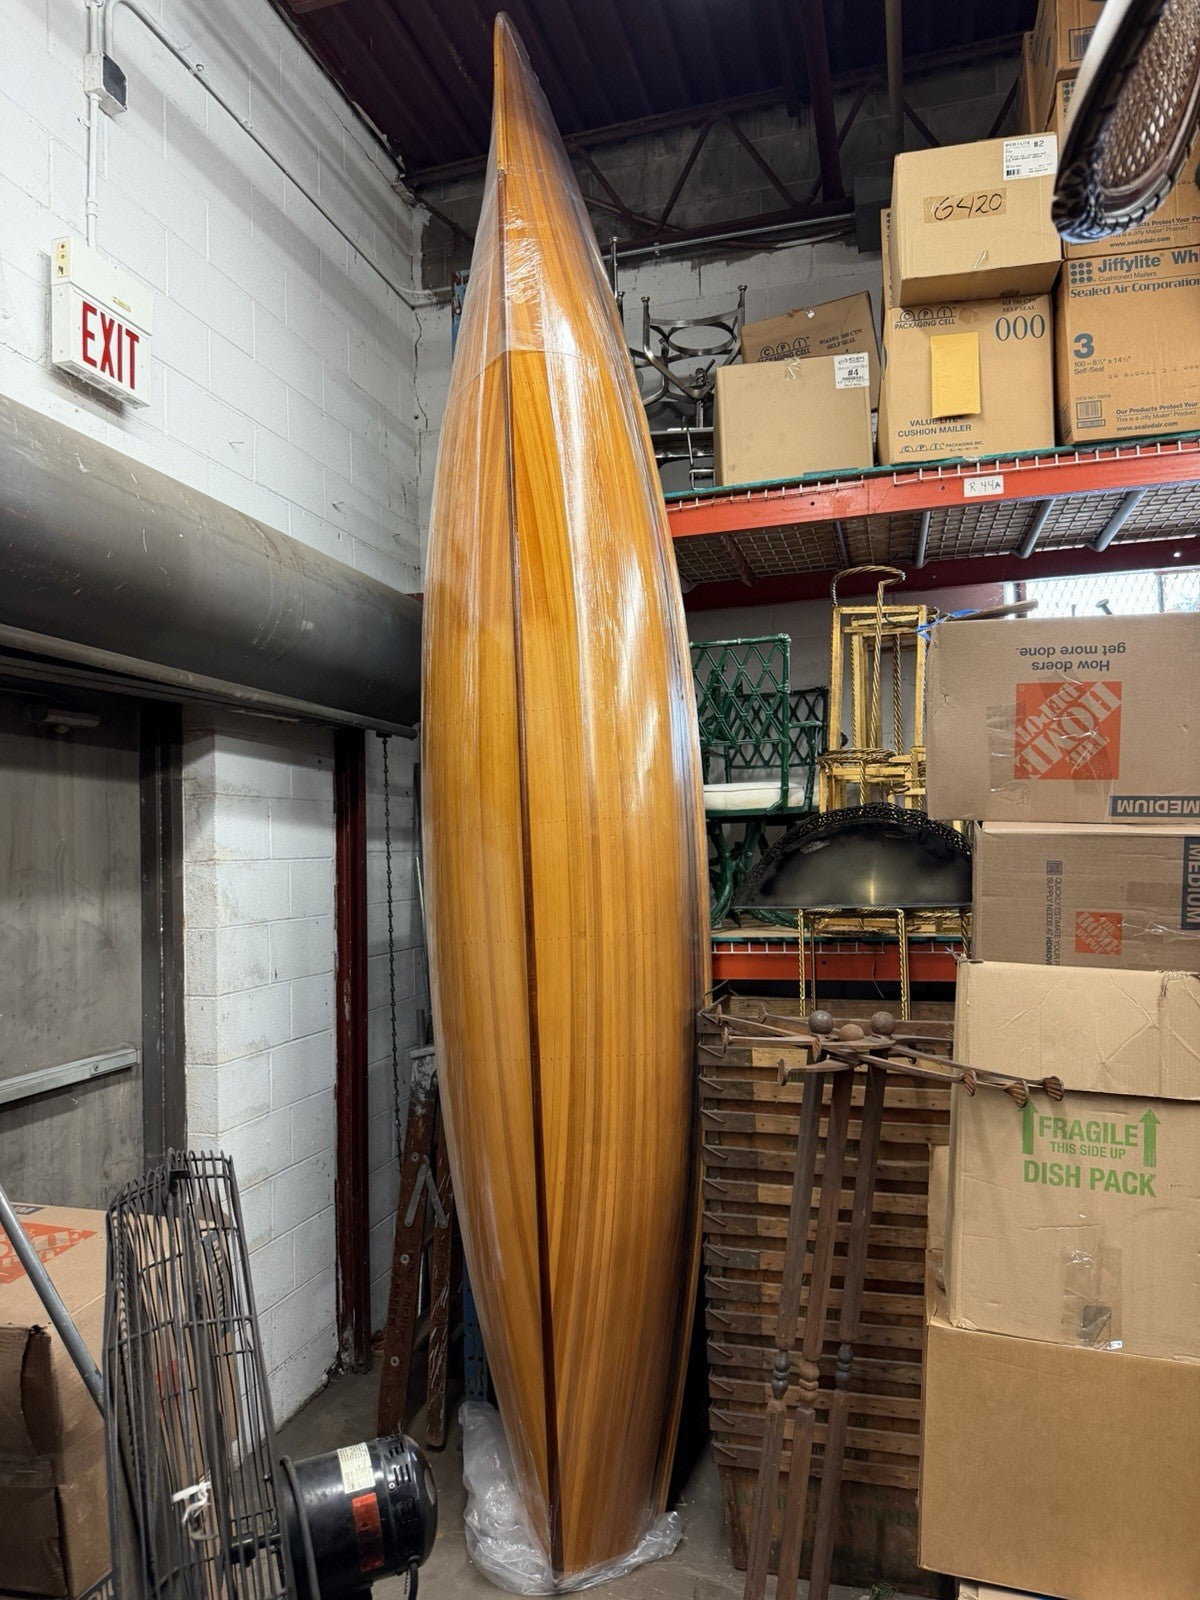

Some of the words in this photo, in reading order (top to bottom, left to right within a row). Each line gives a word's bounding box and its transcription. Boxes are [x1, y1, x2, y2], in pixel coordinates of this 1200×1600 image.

[1109, 236, 1170, 248] www.sealedair.com
[1098, 254, 1161, 273] Jiffylite
[1171, 249, 1200, 265] Wh
[1098, 273, 1132, 282] Cushioned
[1070, 285, 1111, 299] Sealed
[1112, 284, 1130, 294] Air
[895, 320, 937, 330] PACKAGING
[938, 318, 956, 326] CELL
[995, 314, 1045, 342] 000
[82, 300, 139, 390] EXIT
[795, 347, 811, 356] CELL
[1073, 333, 1095, 359] 3
[1074, 360, 1086, 368] 100
[1129, 406, 1158, 414] Products
[1159, 403, 1183, 411] Protect
[897, 428, 937, 438] CUSHION
[939, 424, 972, 434] MAILER
[1116, 421, 1178, 432] www.sealedair.com
[1016, 646, 1056, 658] done.
[1060, 645, 1097, 655] more
[1102, 642, 1126, 656] get
[1031, 661, 1073, 672] doers
[1077, 660, 1110, 671] How
[1014, 681, 1122, 780] HOME
[1117, 799, 1200, 814] MEDIUM
[1187, 844, 1200, 923] MEDIUM
[1054, 877, 1062, 906] QUICKLY
[1038, 1115, 1138, 1147] FRAGILE
[1050, 1141, 1076, 1155] THIS
[1080, 1144, 1107, 1158] SIDE
[1110, 1147, 1126, 1160] UP
[1023, 1160, 1081, 1189] DISH
[1089, 1167, 1157, 1198] PACK
